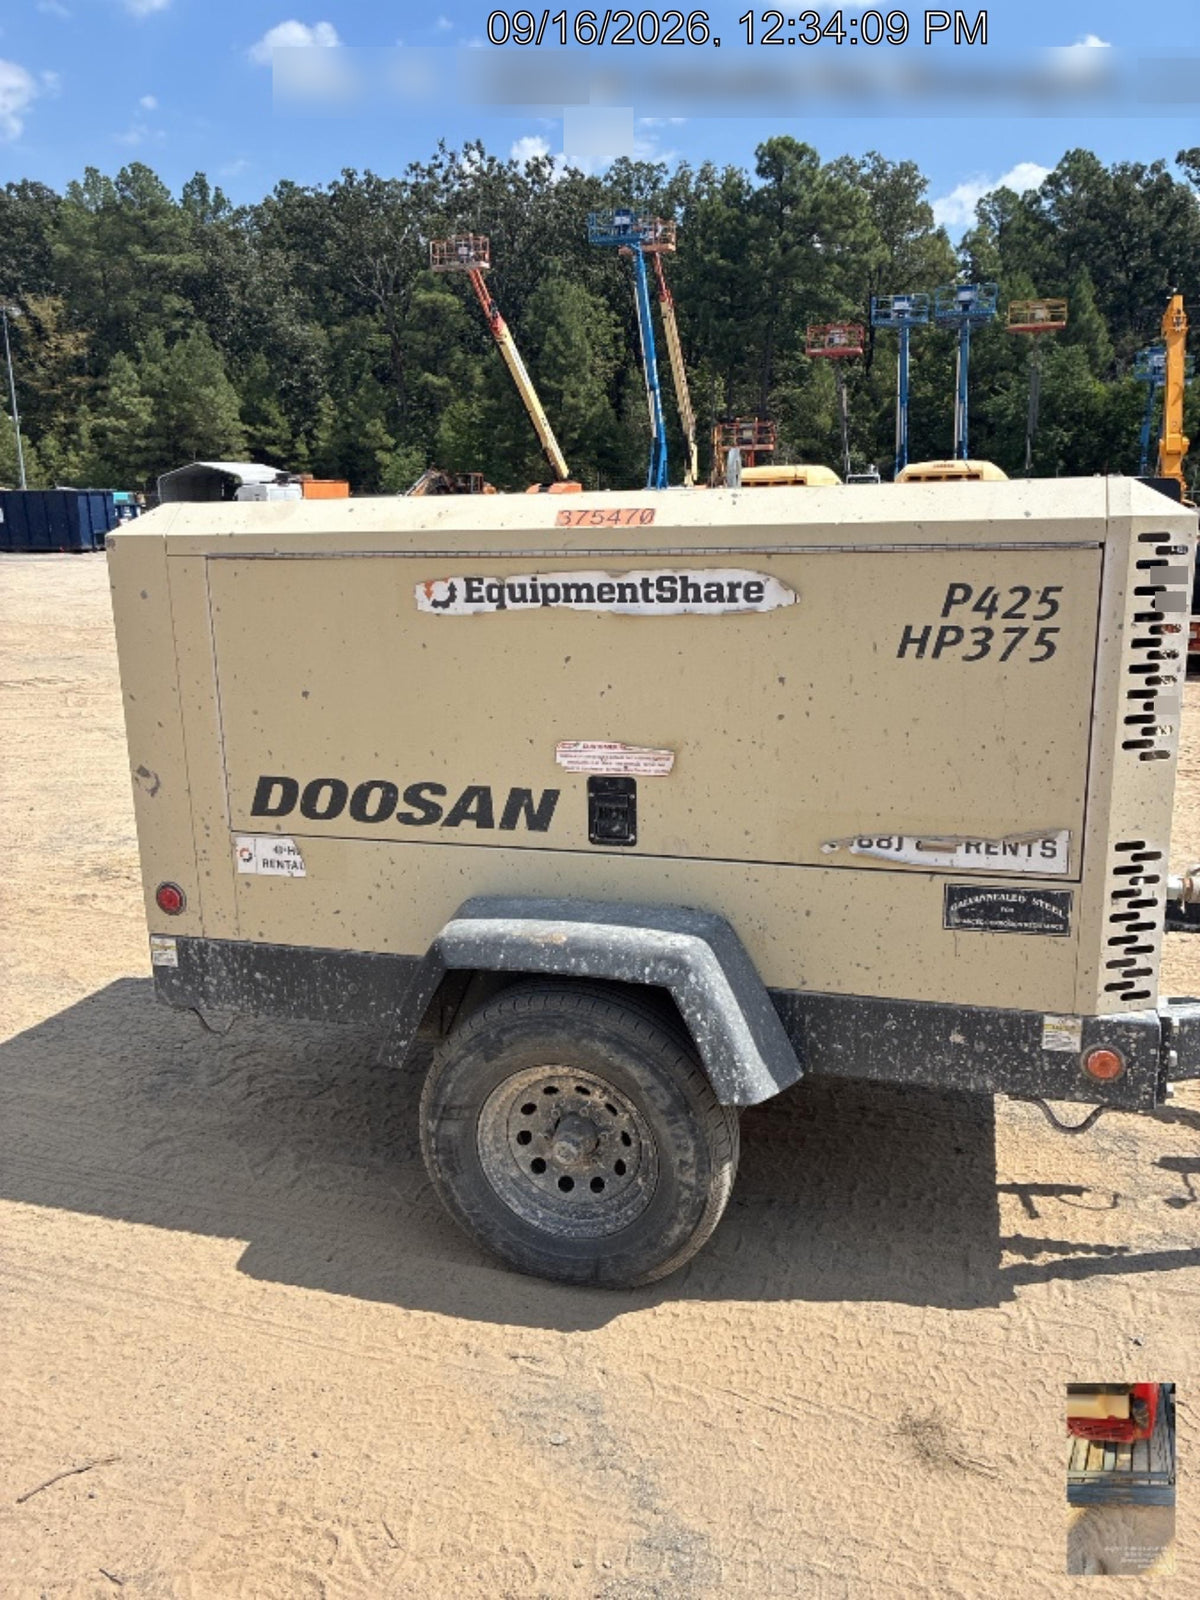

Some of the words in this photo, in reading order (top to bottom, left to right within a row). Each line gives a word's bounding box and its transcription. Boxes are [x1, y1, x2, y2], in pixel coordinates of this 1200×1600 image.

[560, 508, 656, 525] 375470
[463, 575, 765, 610] EquipmentShare
[940, 582, 1064, 621] P425
[896, 625, 1061, 662] HP375
[250, 775, 561, 832] DOOSAN
